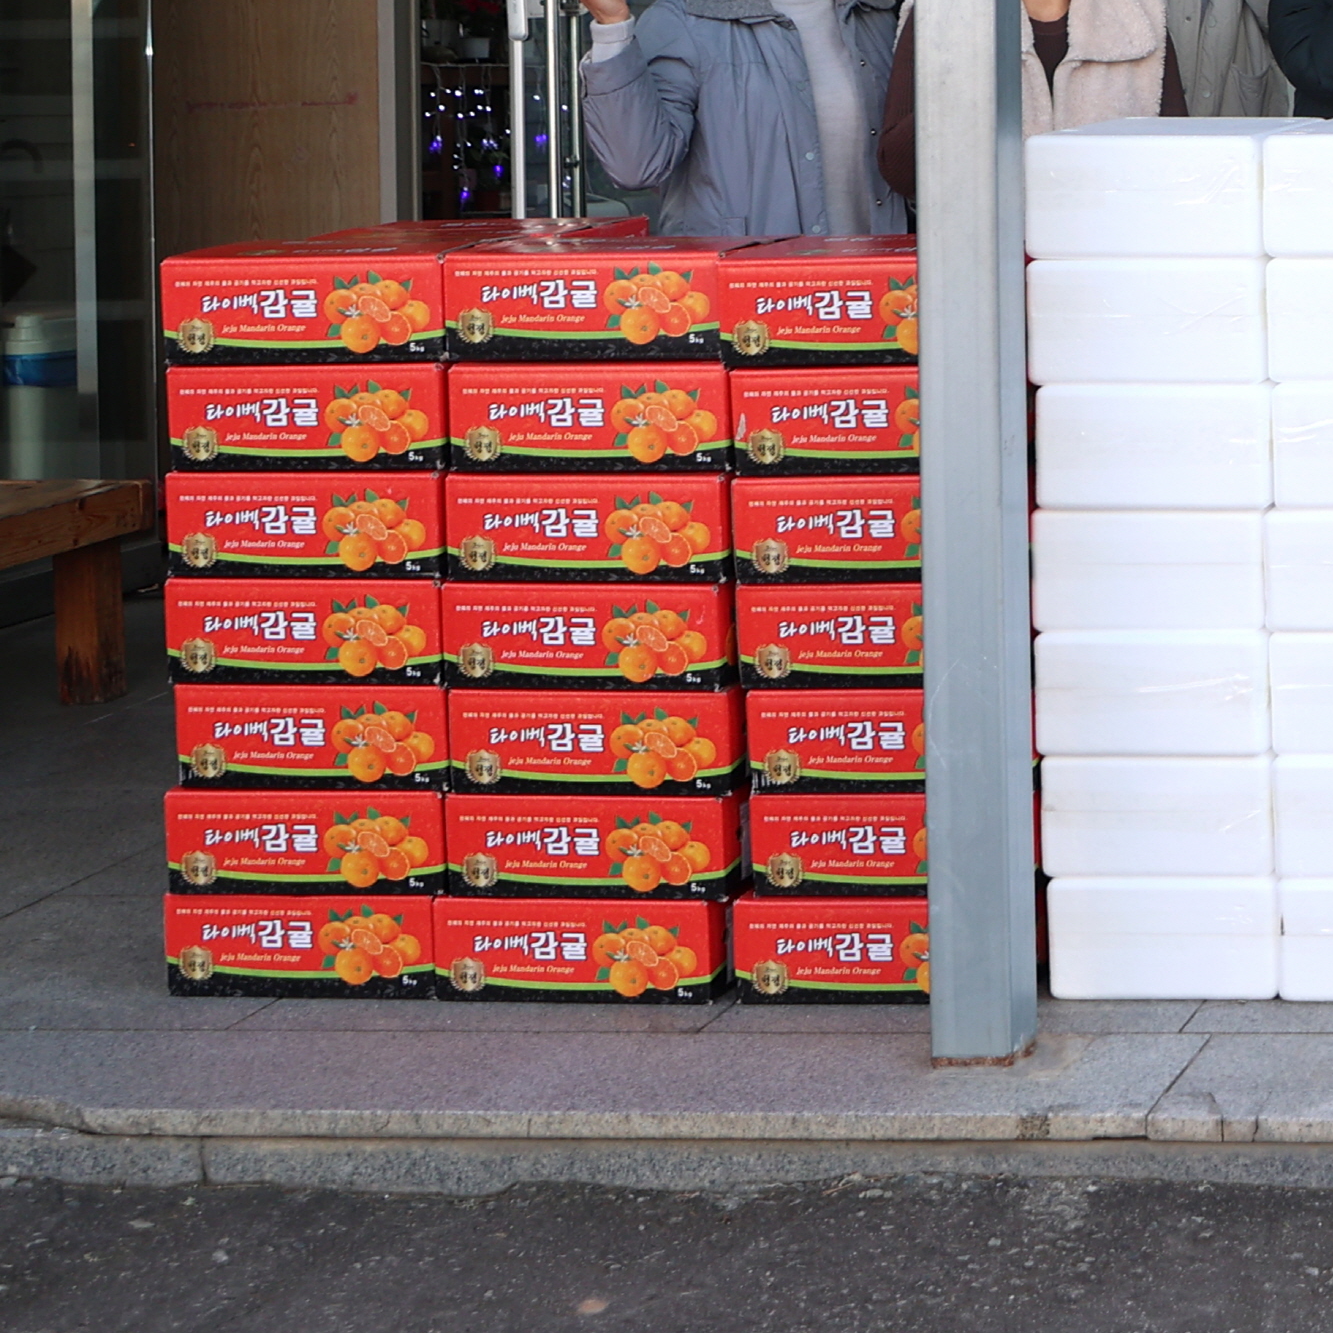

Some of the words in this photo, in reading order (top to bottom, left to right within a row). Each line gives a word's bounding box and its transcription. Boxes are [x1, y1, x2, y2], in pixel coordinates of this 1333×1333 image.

[518, 313, 554, 322] Mandarin
[556, 313, 585, 323] Orange
[242, 431, 277, 440] Mandarin
[279, 431, 307, 441] Orange
[813, 966, 850, 975] Mandarin
[852, 966, 881, 976] Orange
